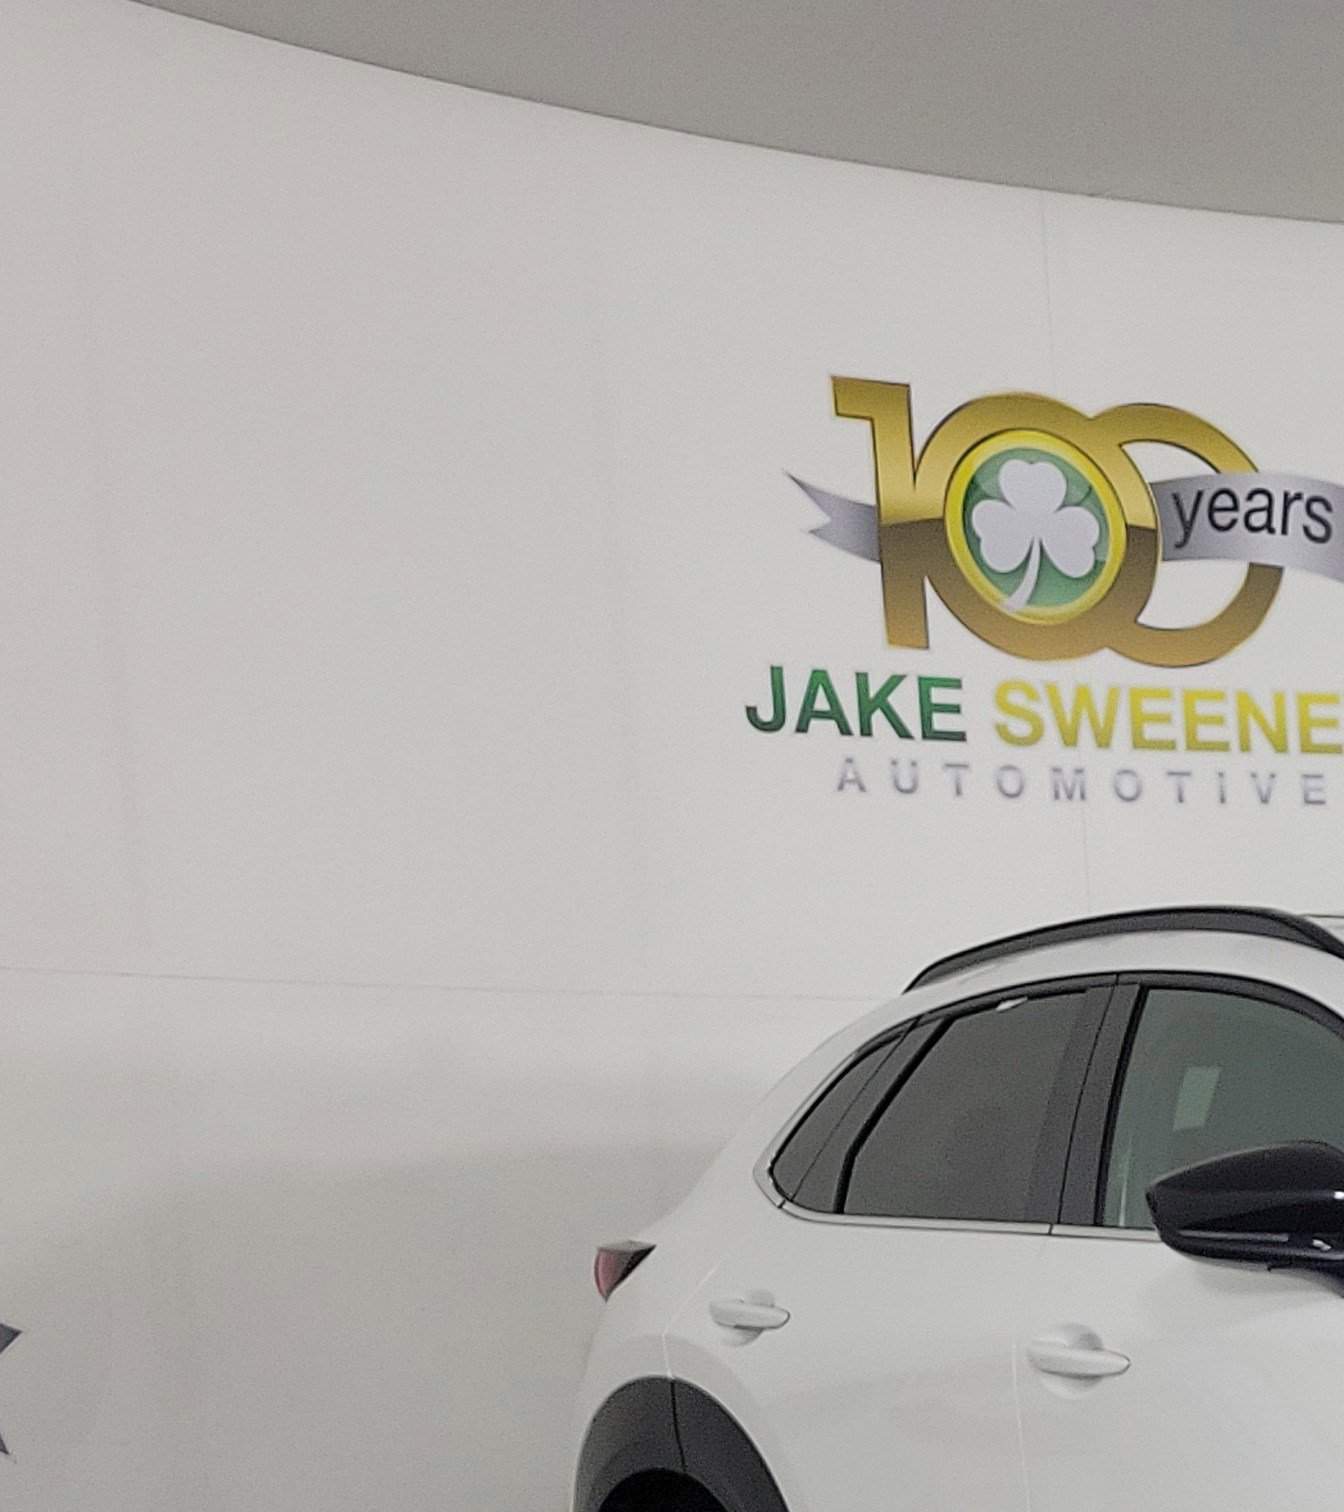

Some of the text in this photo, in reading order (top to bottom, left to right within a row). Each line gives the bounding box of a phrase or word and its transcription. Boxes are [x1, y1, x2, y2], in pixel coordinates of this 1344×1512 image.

[830, 374, 1334, 668] 100 years
[745, 664, 967, 742] JAKE
[835, 757, 1328, 807] AUTOMOTIVE
